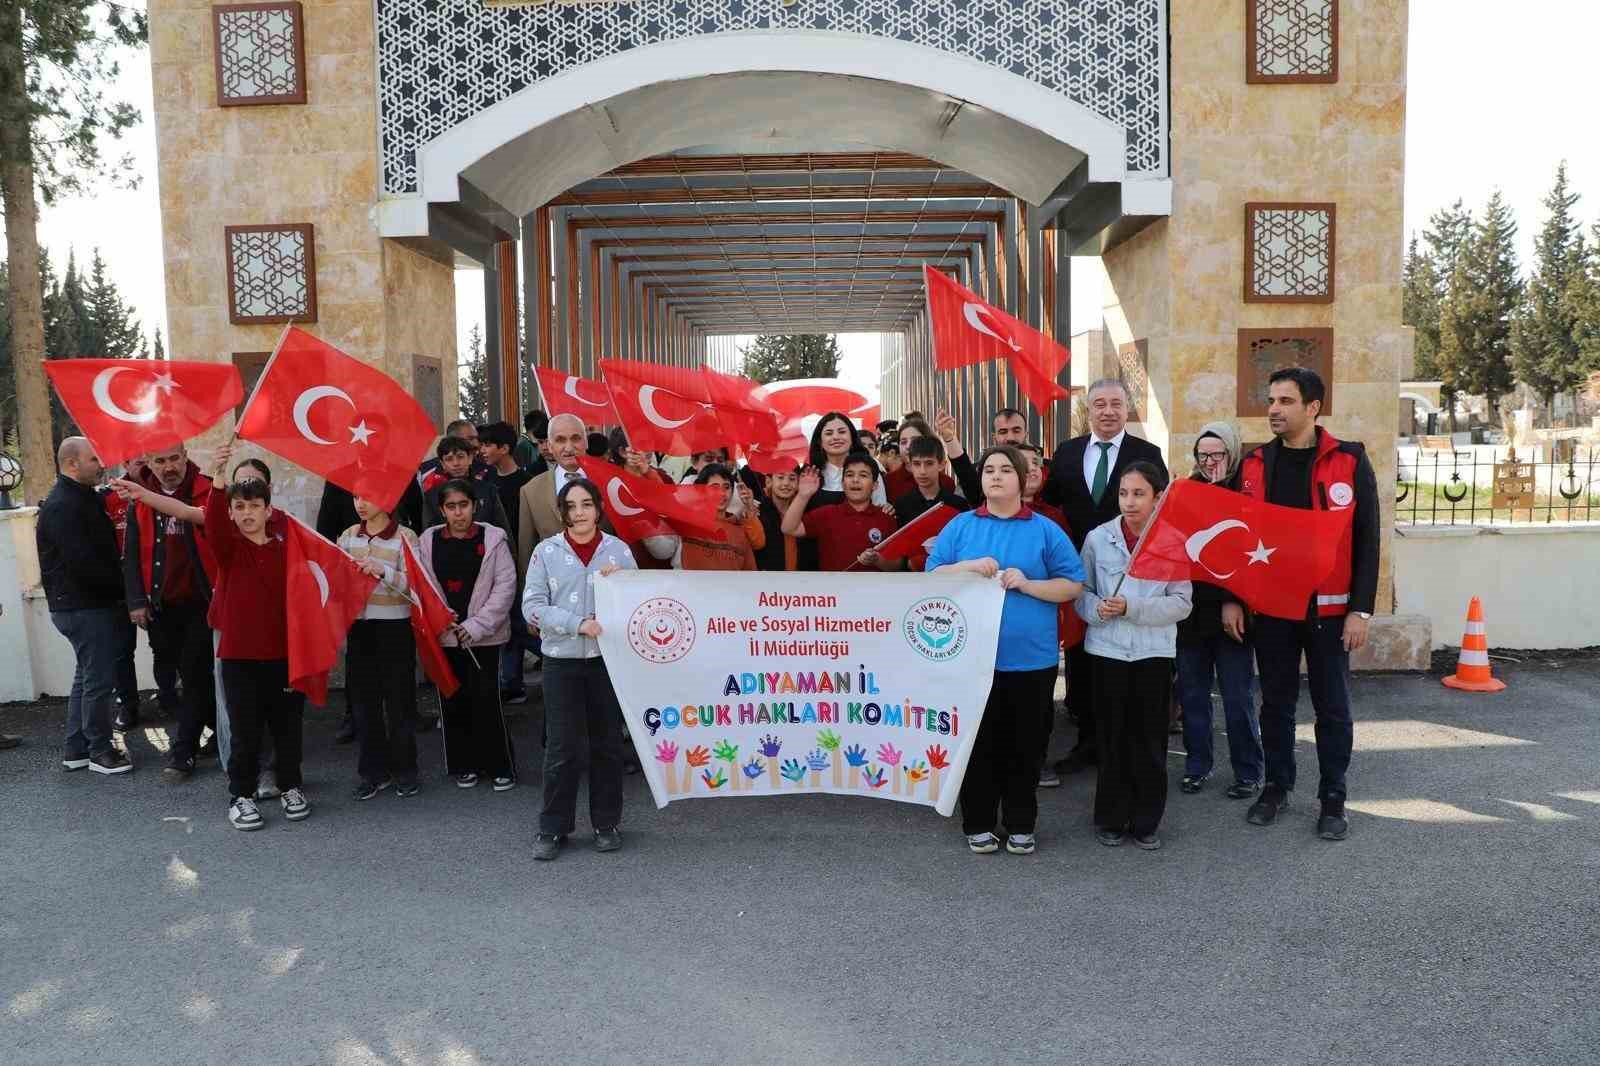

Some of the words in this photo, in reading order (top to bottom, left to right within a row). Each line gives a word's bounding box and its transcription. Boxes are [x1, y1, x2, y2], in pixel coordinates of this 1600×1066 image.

[758, 591, 837, 611] Adıyaman
[706, 617, 736, 634] Aile
[740, 619, 757, 632] ve
[761, 616, 810, 636] Sosyal
[814, 616, 892, 633] Hizmetler
[750, 637, 759, 657] İl
[764, 639, 849, 660] Müdürlüğü
[723, 671, 851, 697] ADIYAMAN
[858, 663, 880, 695] İL
[643, 704, 732, 737] ÇOCUK
[738, 701, 840, 725] HAKLARI
[847, 697, 959, 737] KOMİTESİ
